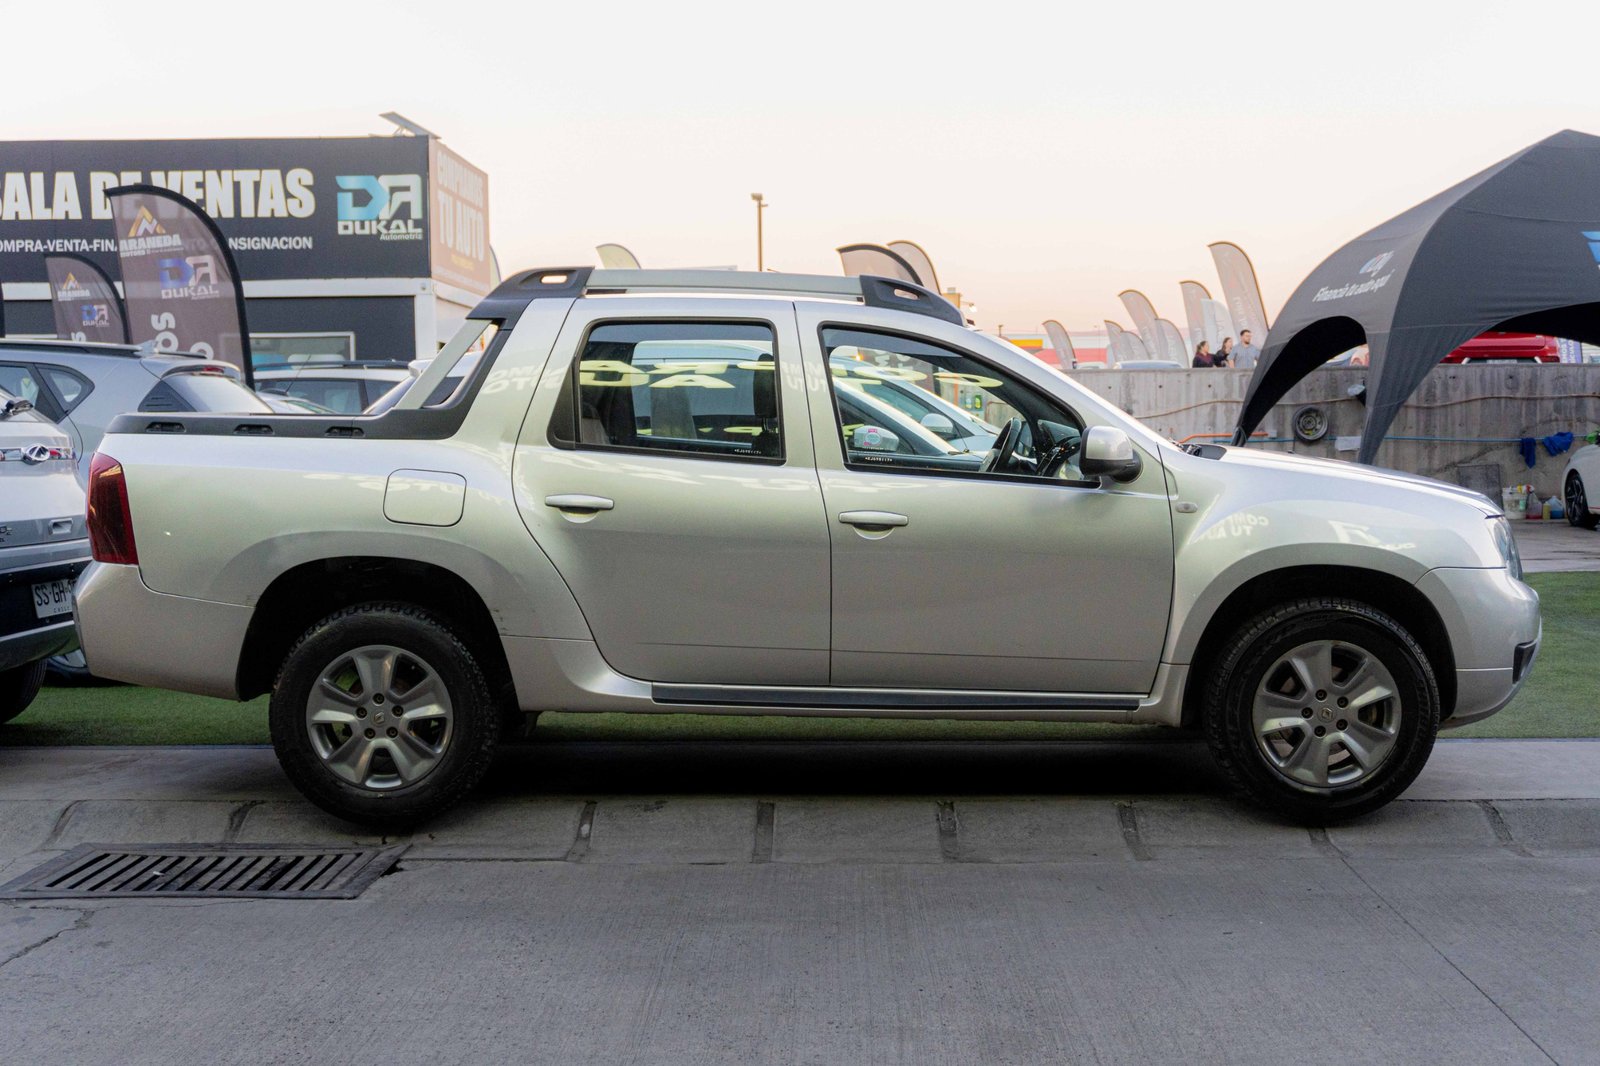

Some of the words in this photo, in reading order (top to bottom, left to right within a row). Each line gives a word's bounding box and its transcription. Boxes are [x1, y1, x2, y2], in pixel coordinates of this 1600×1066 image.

[0, 172, 82, 220] ALA
[150, 168, 316, 218] VENTAS
[338, 219, 422, 235] DUKAL
[120, 233, 182, 252] ARANEDA
